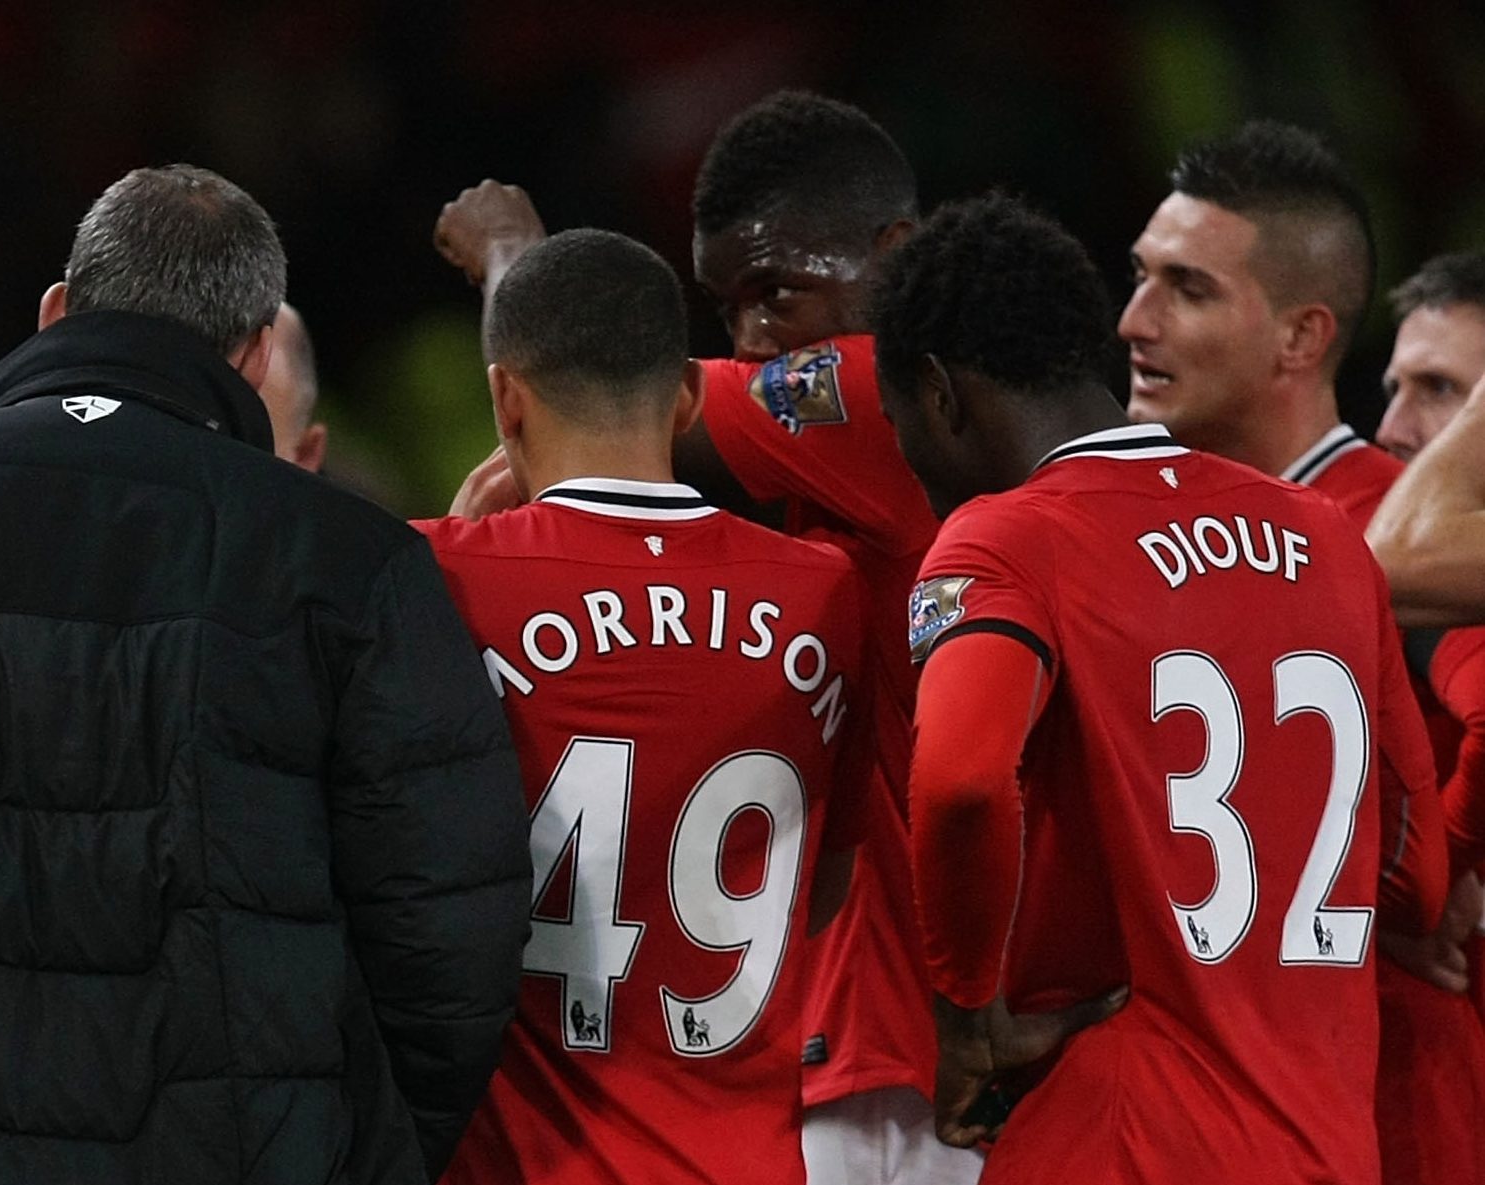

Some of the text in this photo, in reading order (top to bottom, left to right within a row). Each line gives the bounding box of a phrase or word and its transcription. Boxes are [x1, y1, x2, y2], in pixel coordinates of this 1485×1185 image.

[1137, 515, 1310, 589] DIOUF
[521, 735, 807, 1057] 49
[1151, 649, 1375, 967] 32
